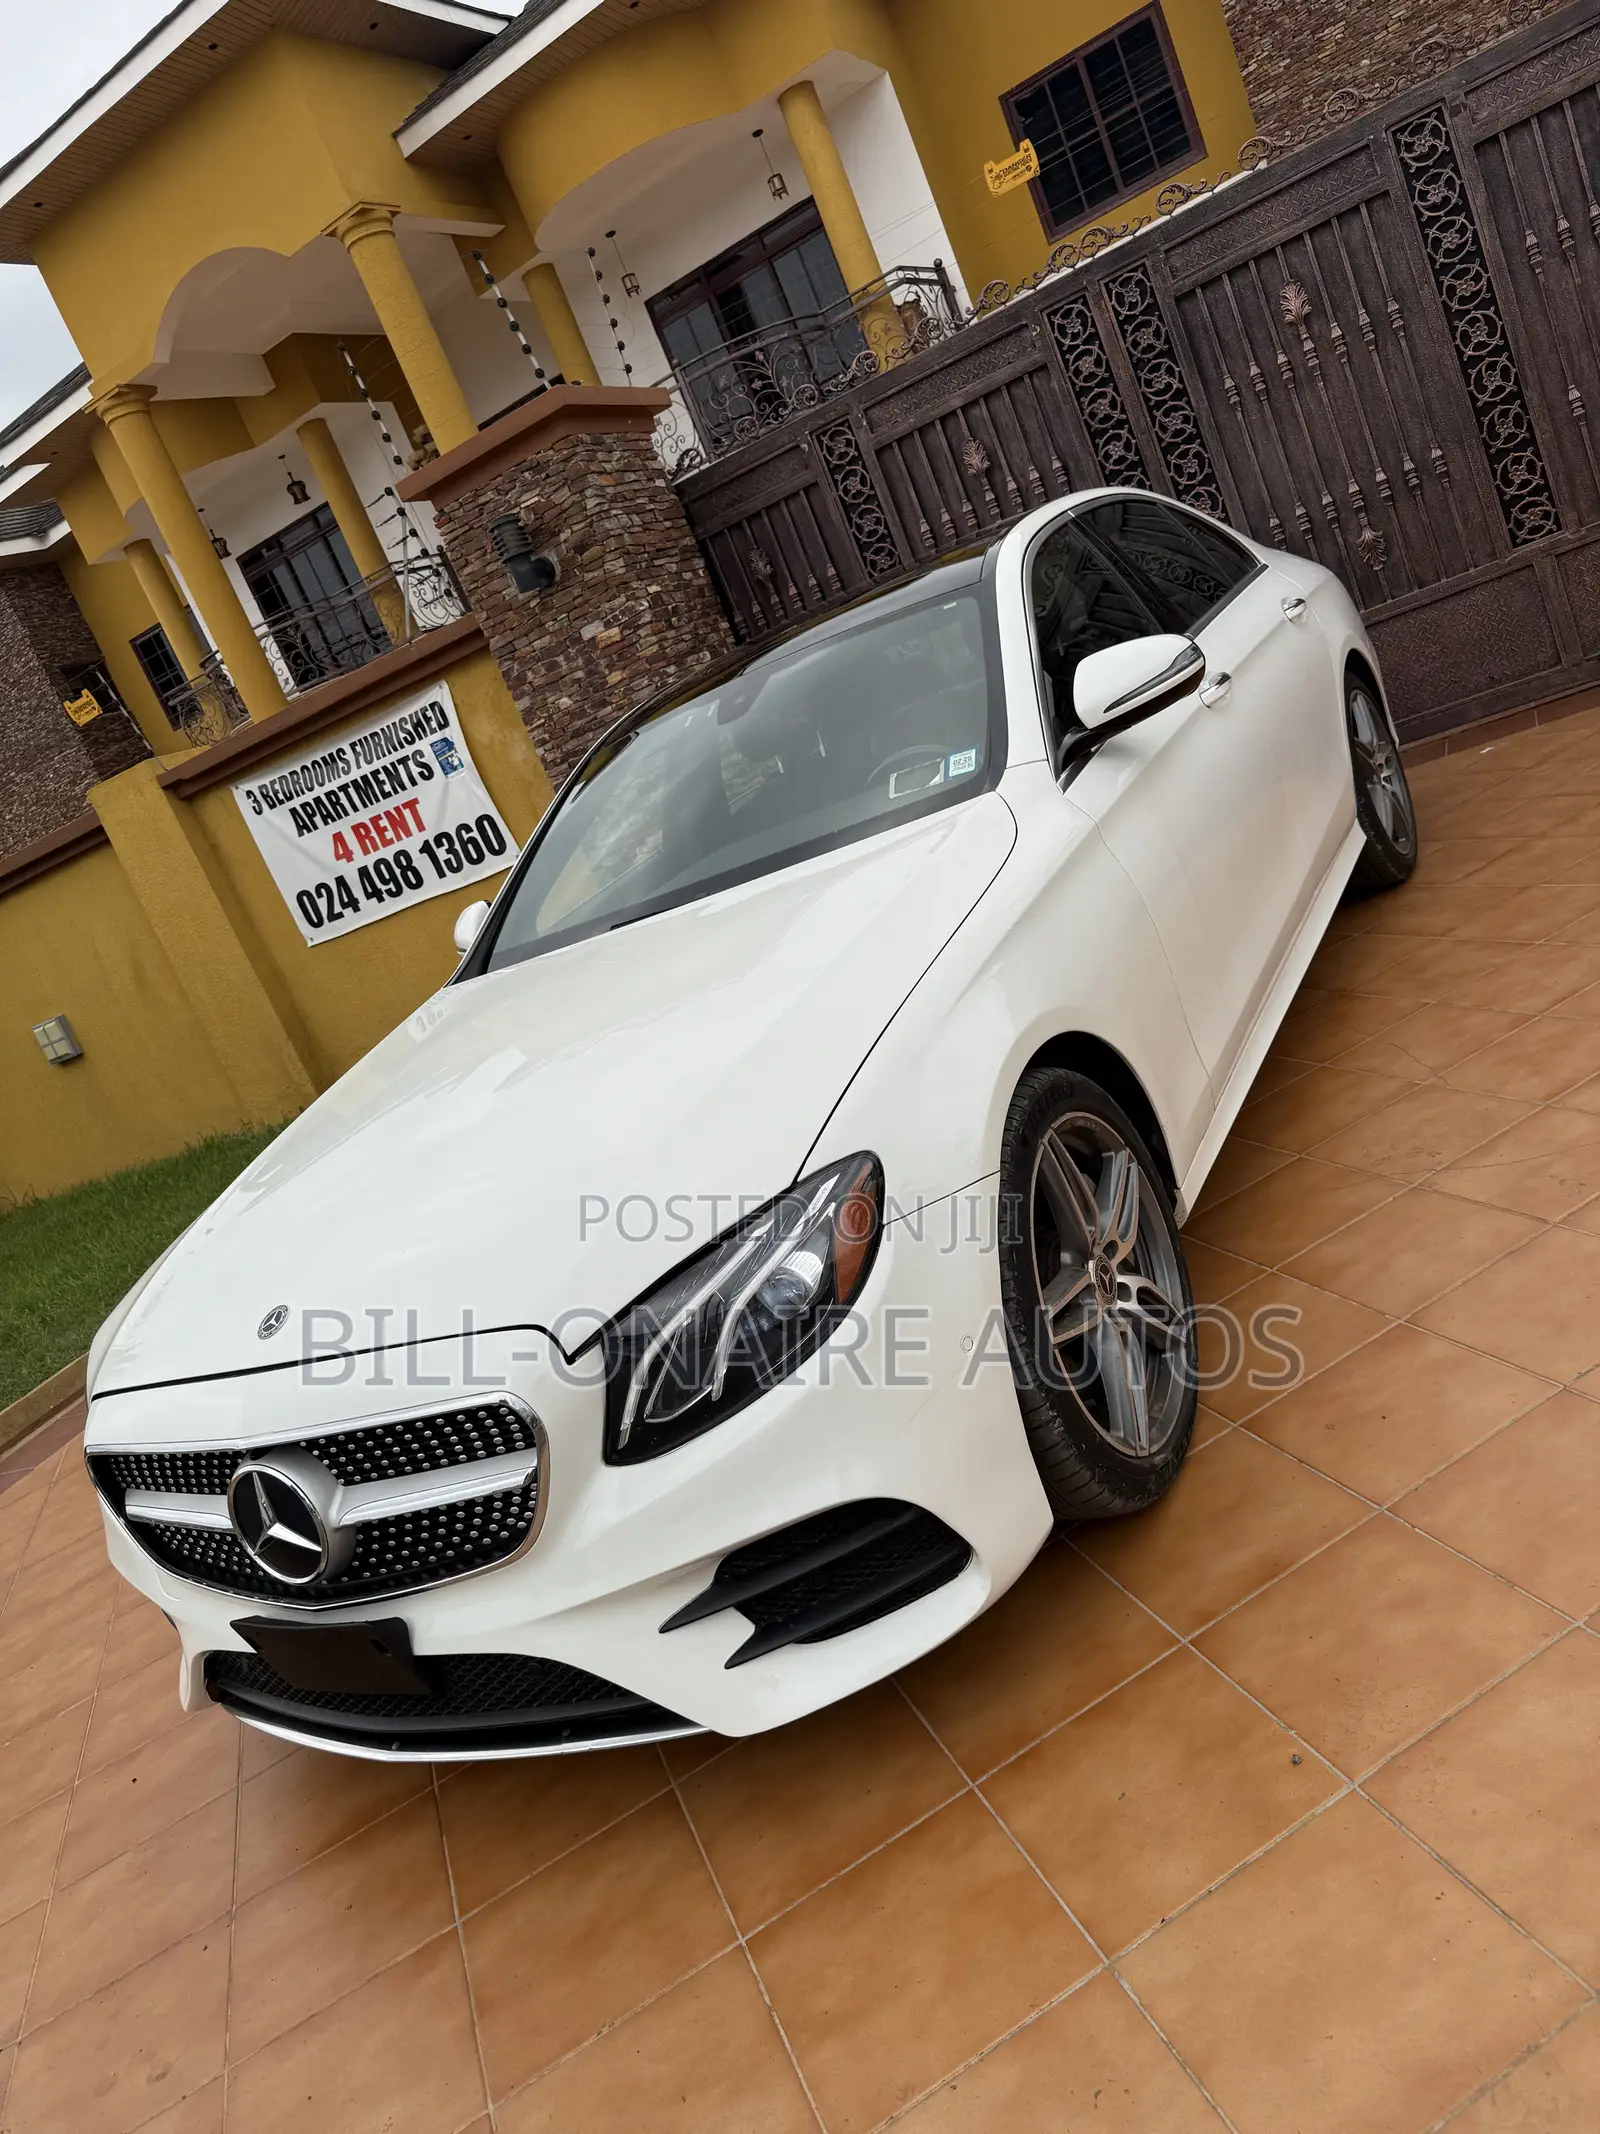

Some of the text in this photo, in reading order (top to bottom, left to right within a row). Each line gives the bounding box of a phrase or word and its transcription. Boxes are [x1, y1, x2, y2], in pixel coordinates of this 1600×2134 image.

[1002, 153, 1032, 174] DANGER
[246, 789, 264, 816] 3
[257, 747, 352, 811] BEDROOMS
[349, 700, 450, 770] FURNISHED
[288, 749, 435, 838] APARTMENTS
[295, 813, 507, 929] 024 498 1360
[331, 797, 427, 864] 4 RENT
